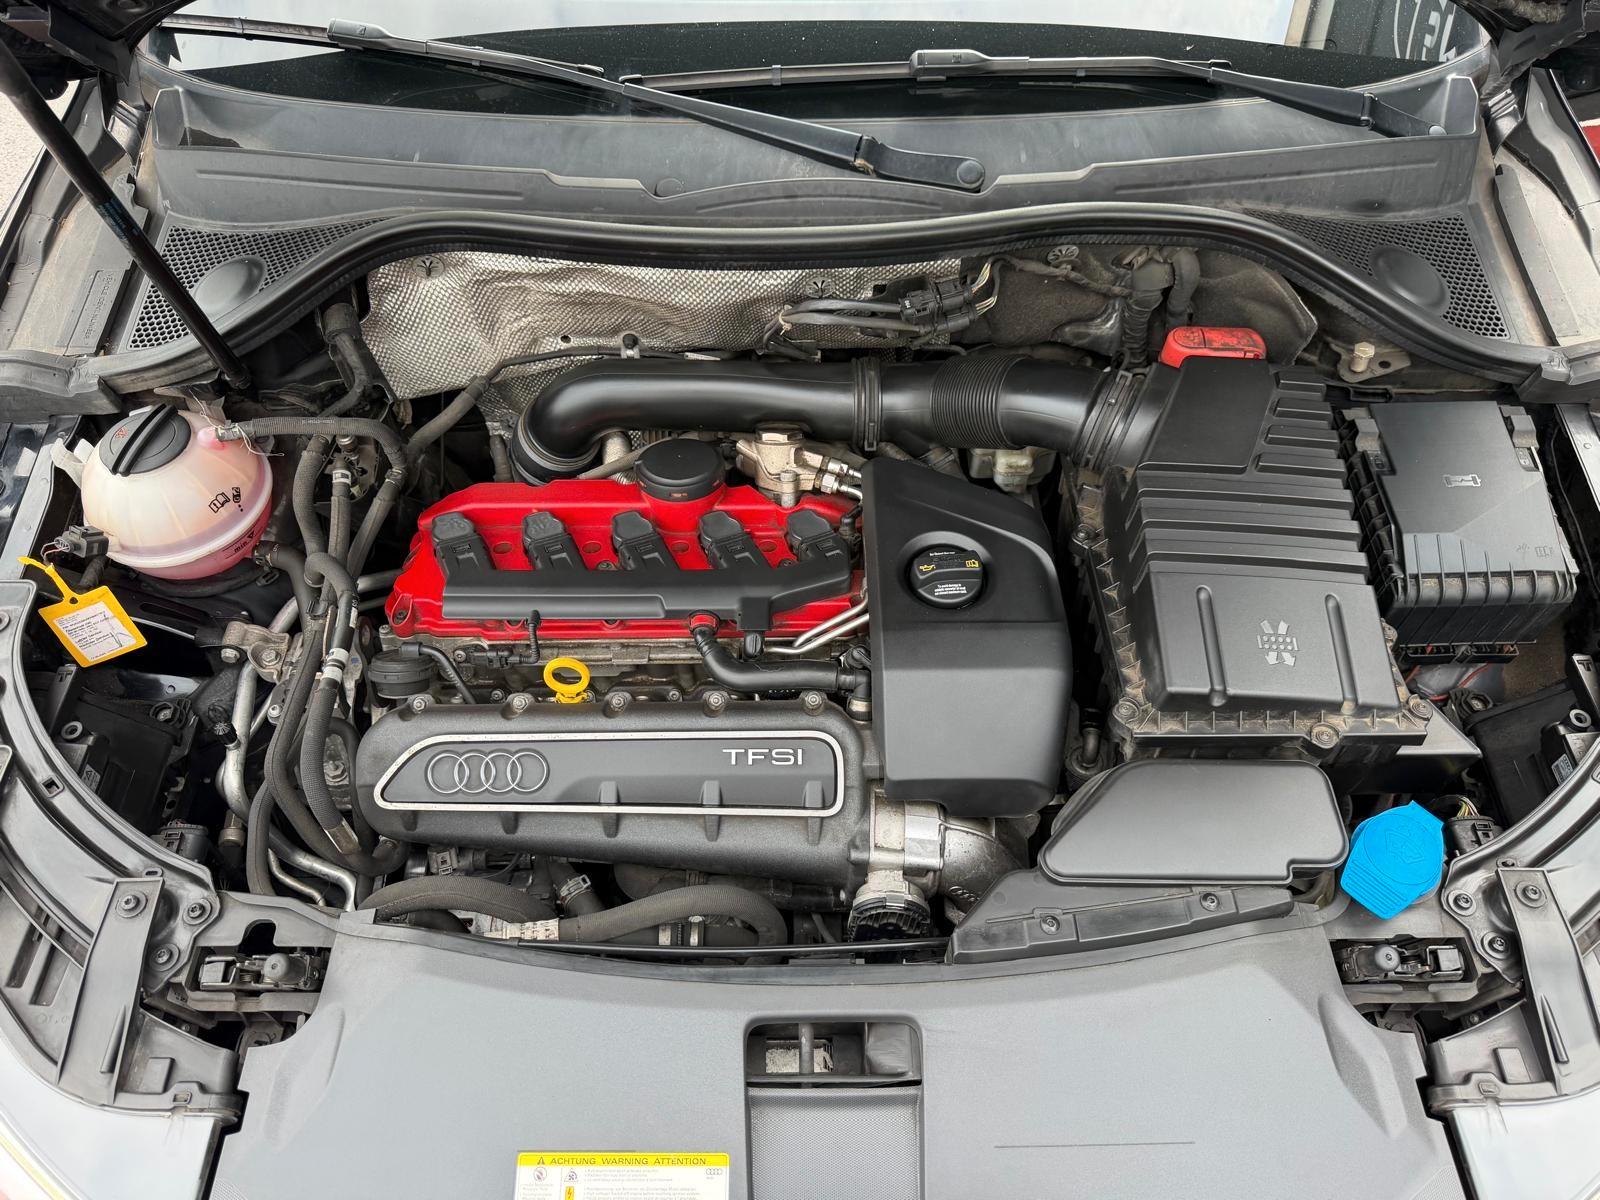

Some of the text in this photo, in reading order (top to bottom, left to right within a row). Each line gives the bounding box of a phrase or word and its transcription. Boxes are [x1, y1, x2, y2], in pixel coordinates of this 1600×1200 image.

[722, 748, 803, 766] TFSI
[550, 1157, 706, 1166] ACHTUNG WARNING ATTENTION
